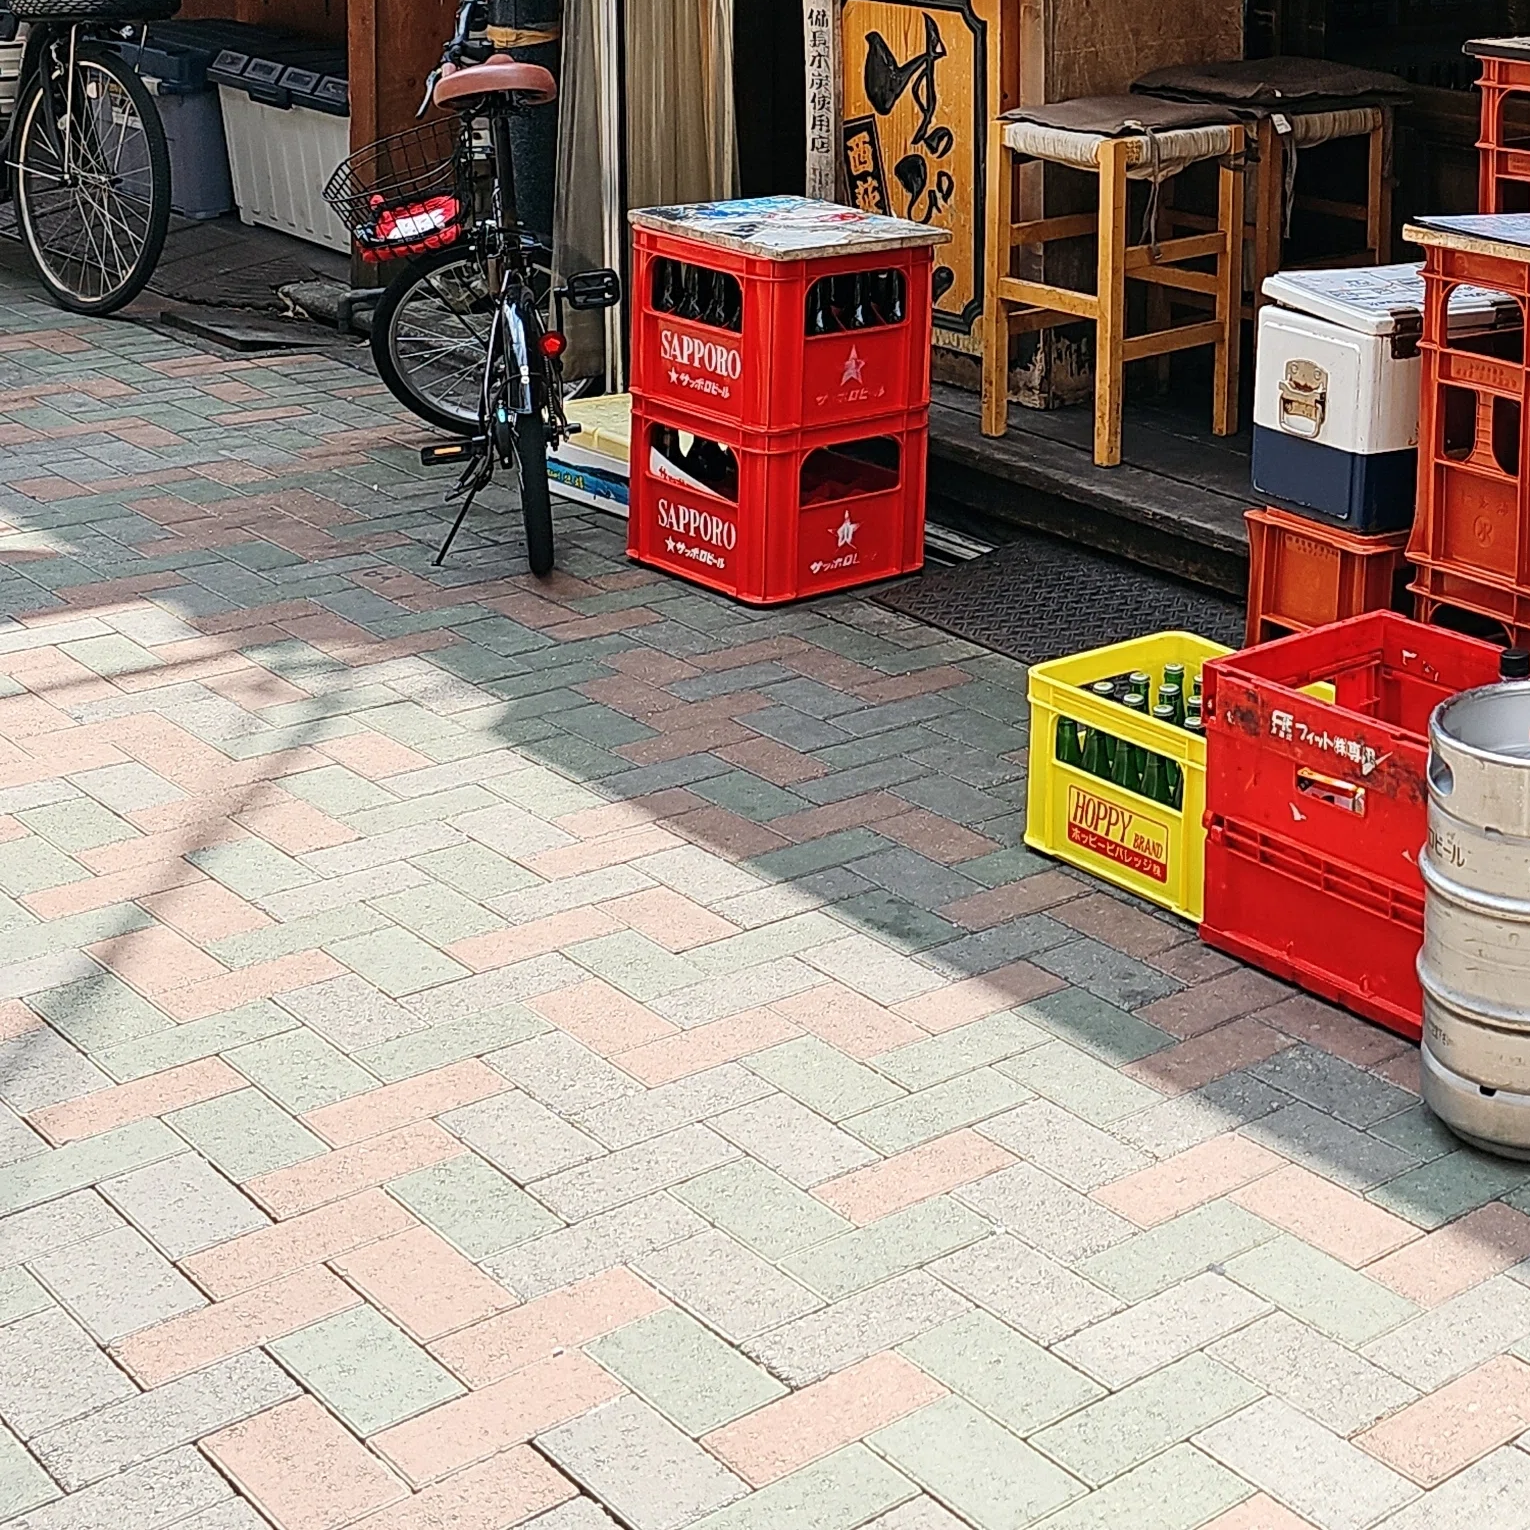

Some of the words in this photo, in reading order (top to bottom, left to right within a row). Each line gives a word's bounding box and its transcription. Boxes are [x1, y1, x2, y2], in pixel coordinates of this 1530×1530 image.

[864, 11, 957, 306] すっぴ
[661, 330, 742, 380] SAPPORO
[679, 373, 730, 399] サッポロビール
[658, 498, 737, 551] SAPPORO
[676, 540, 726, 569] サッポロビール
[1073, 791, 1133, 844] HOPPY
[1132, 832, 1163, 860] BRAND
